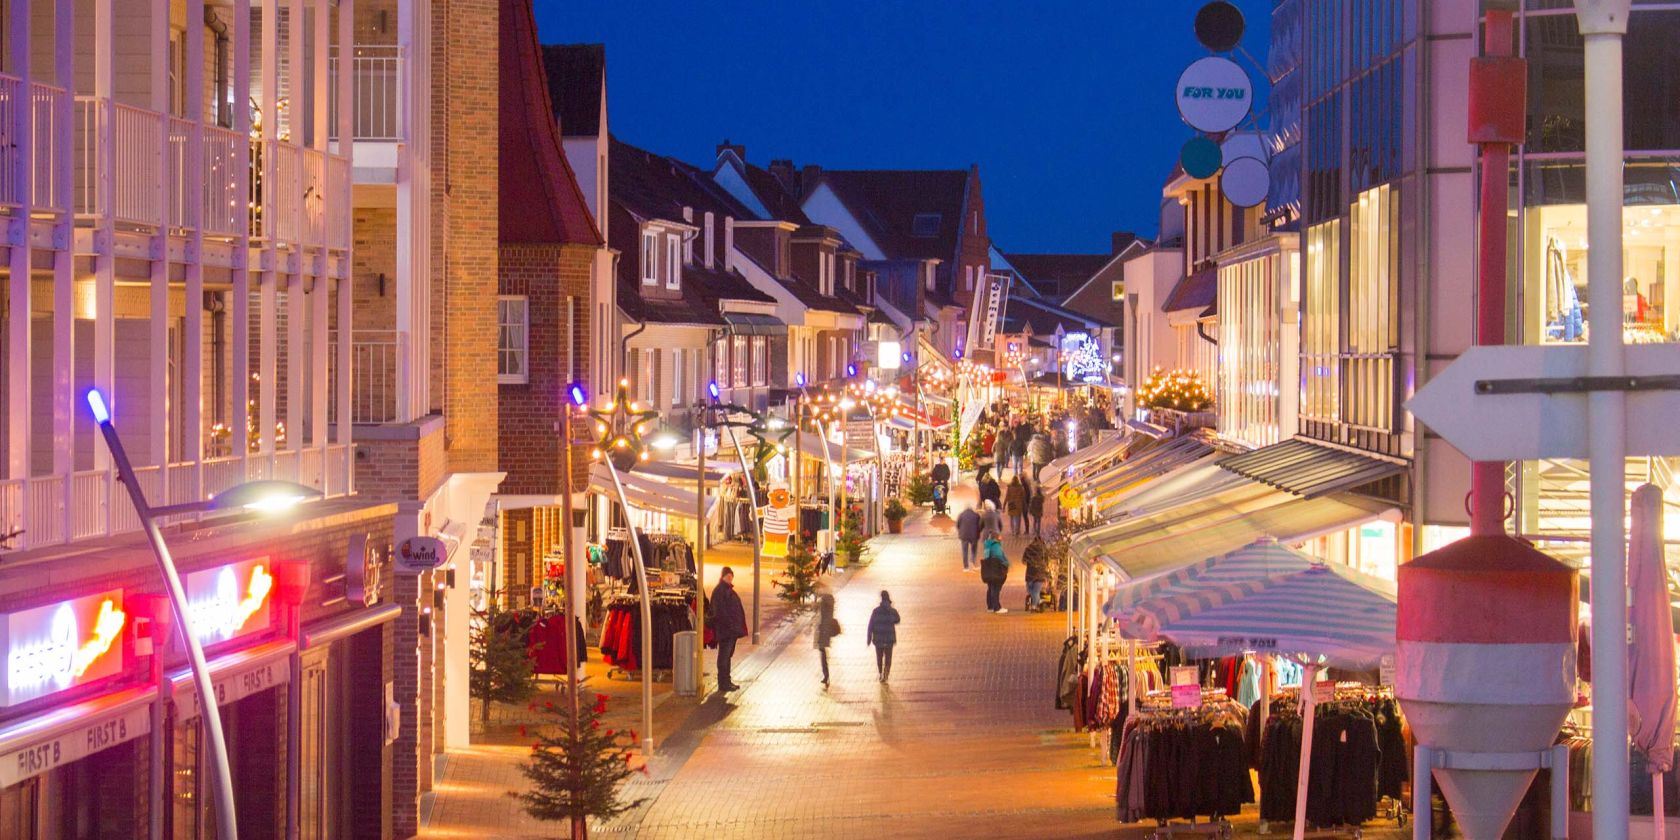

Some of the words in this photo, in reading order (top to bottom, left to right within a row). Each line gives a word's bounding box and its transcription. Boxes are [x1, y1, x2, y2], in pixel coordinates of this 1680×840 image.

[1183, 87, 1213, 98] FOR
[1217, 88, 1245, 99] YOU
[87, 721, 117, 751] FIRST
[119, 718, 127, 738] B
[17, 743, 50, 775] FIRST
[53, 741, 61, 763] B
